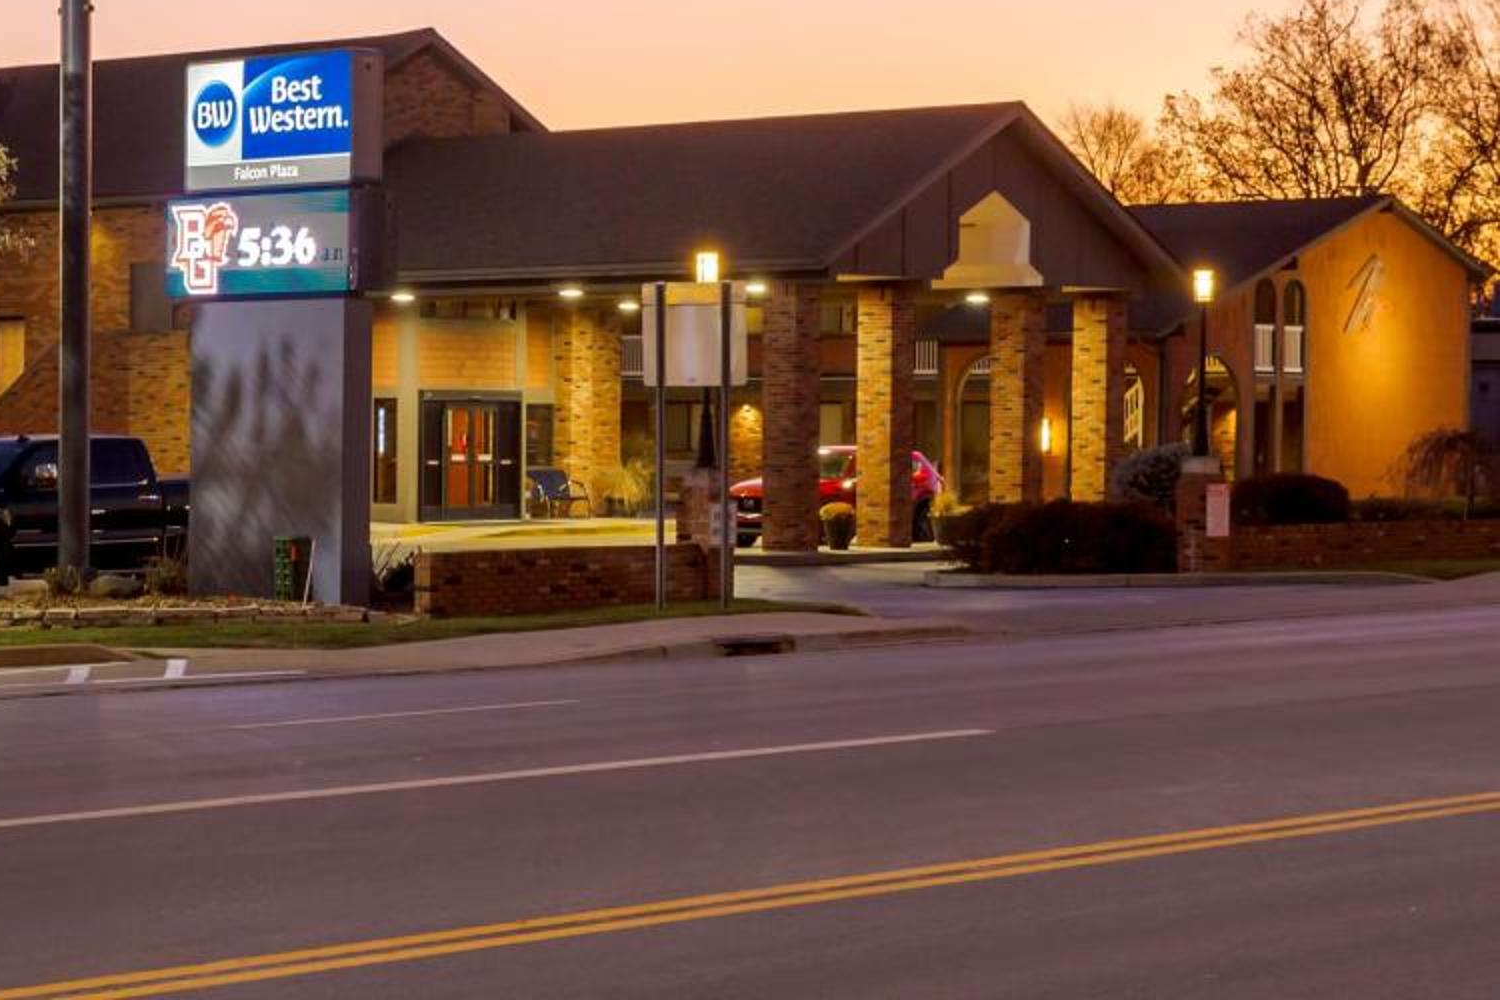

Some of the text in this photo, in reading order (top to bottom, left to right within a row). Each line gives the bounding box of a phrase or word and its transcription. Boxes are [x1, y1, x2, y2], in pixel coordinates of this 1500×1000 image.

[270, 74, 322, 105] Best
[197, 99, 234, 129] BW
[233, 163, 299, 182] Falcon Plaza
[237, 225, 317, 267] 5:36
